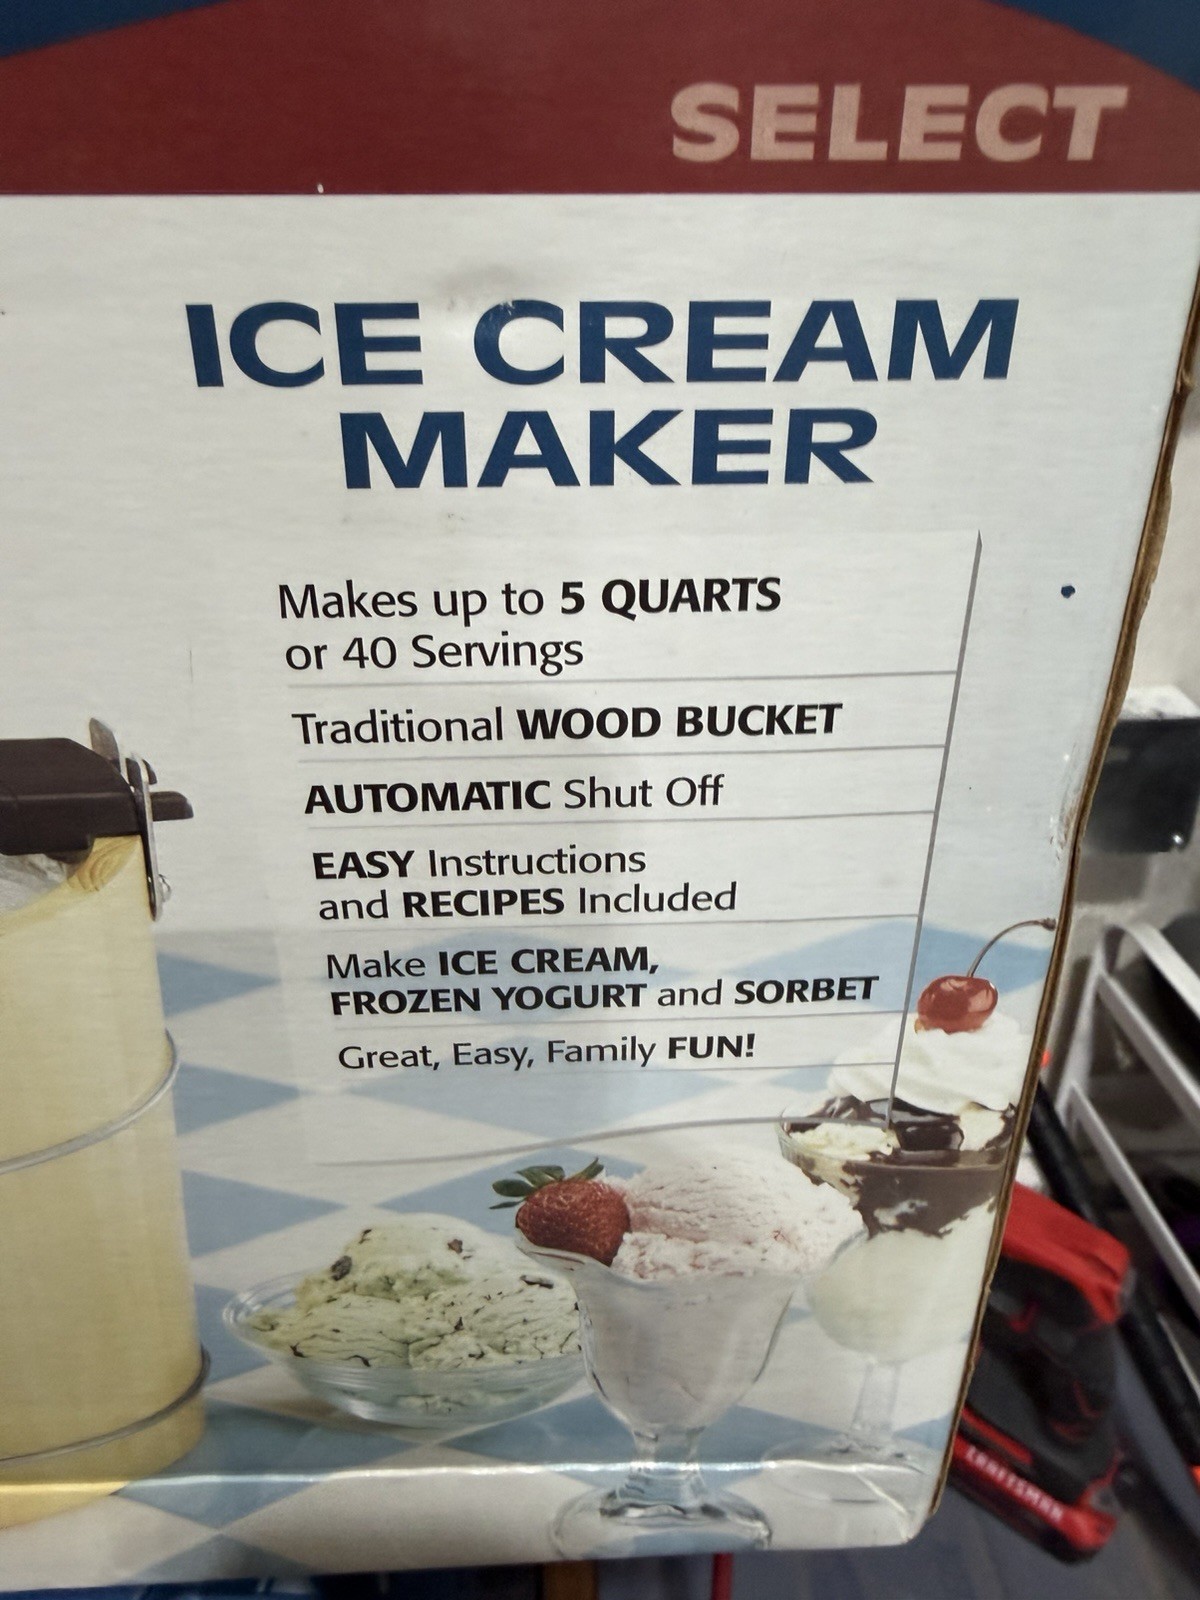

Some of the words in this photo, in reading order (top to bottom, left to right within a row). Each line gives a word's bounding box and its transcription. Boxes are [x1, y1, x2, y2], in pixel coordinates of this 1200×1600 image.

[670, 81, 1129, 163] SELECT
[185, 301, 423, 388] ICE
[473, 299, 1020, 386] CREAM
[339, 408, 878, 490] MAKER
[278, 579, 418, 619] Makes
[433, 589, 487, 628] up
[501, 582, 544, 616] to
[561, 581, 585, 615] 5
[601, 576, 781, 622] QUARTS
[285, 644, 328, 671] or
[342, 636, 397, 669] 40
[411, 630, 584, 677] Servings
[291, 706, 503, 745] Traditional
[516, 707, 661, 740] WOOD
[676, 703, 844, 737] BUCKET
[304, 780, 551, 815] AUTOMATIC
[564, 775, 653, 809] Shut
[666, 773, 725, 807] Off
[312, 850, 415, 880] EASY
[428, 844, 646, 877] Instructions
[319, 889, 389, 921] and
[402, 887, 565, 918] RECIPES
[579, 881, 737, 914] Included
[326, 949, 426, 980] Make
[438, 949, 498, 977] ICE
[510, 946, 659, 975] CREAM,
[330, 987, 481, 1016] FROZEN
[490, 983, 648, 1011] YOGURT
[657, 978, 723, 1007] and
[734, 975, 880, 1005] SORBET
[338, 1045, 440, 1071] Great,
[453, 1042, 534, 1072] Easy,
[547, 1035, 656, 1068] Family
[668, 1033, 755, 1060] FUN!
